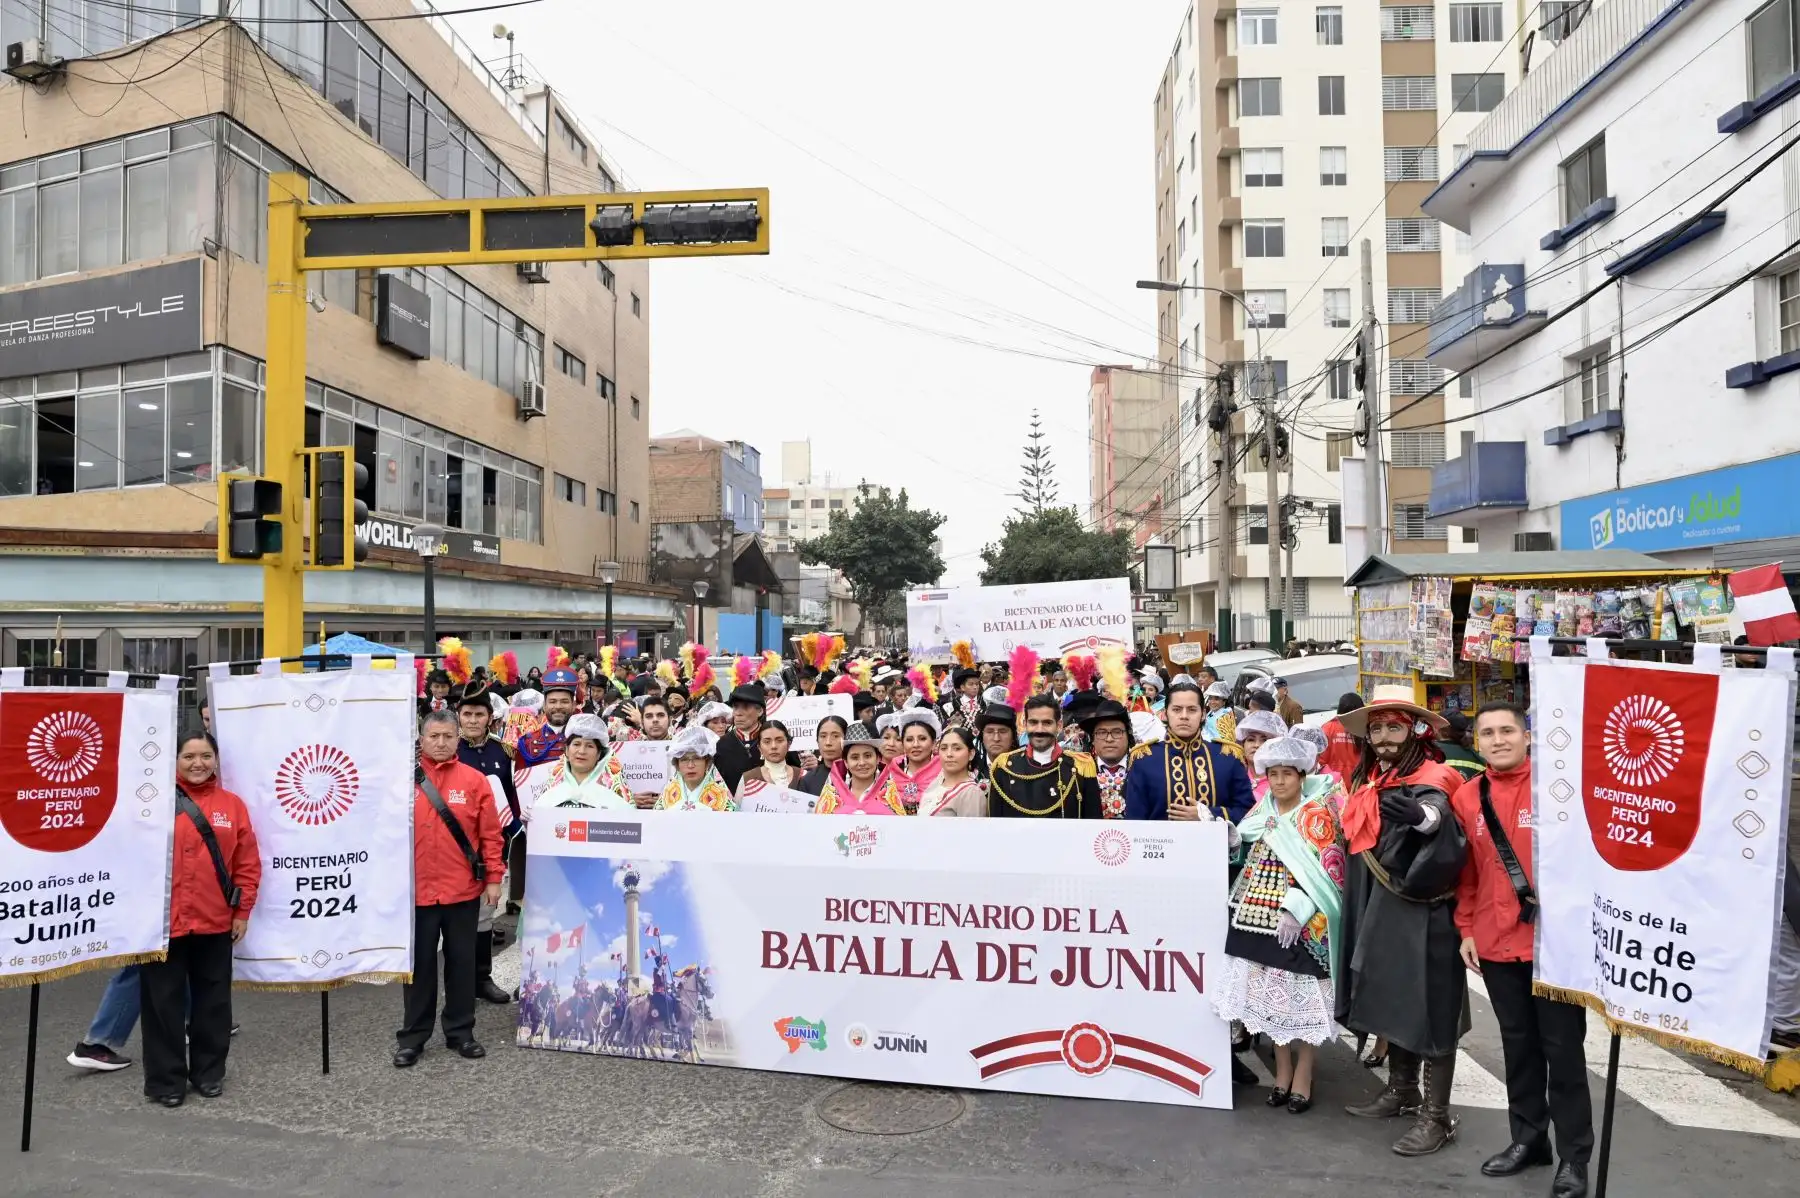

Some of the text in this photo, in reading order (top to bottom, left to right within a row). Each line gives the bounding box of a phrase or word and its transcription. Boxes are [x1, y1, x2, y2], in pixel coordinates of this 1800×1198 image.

[28, 334, 50, 343] DANZA
[51, 326, 95, 339] PROFESIONAL
[1616, 485, 1741, 535] Boticas y Salud
[1004, 602, 1103, 616] BICENTENARIO DE LA
[983, 613, 1127, 633] BATALLA DE AYACUCHO
[16, 785, 101, 801] BICENTENARIO
[45, 796, 82, 812] PERÚ
[1593, 786, 1676, 814] BICENTENARIO
[40, 813, 85, 829] 2024
[1611, 806, 1649, 825] PERÚ
[1607, 822, 1654, 848] 2024
[272, 850, 369, 869] BICENTENARIO
[1143, 851, 1165, 859] 2024
[1, 870, 111, 894] 200 años de la
[296, 867, 352, 892] PERÚ
[0, 889, 116, 921] Batalla de
[290, 894, 358, 919] 2024
[824, 897, 1129, 936] BICENTENARIO DE LA
[1602, 899, 1633, 922] años
[1639, 912, 1664, 929] de
[1669, 917, 1688, 935] la
[14, 911, 96, 945] Junín
[9, 956, 24, 967] de
[31, 950, 68, 966] agosto
[71, 946, 82, 956] de
[87, 940, 109, 953] 1824
[761, 930, 1205, 995] BATALLA DE JUNÍN
[1653, 941, 1696, 971] de
[1633, 1008, 1650, 1024] de
[1658, 1013, 1689, 1033] 1824
[873, 1034, 928, 1054] JUNÍN
